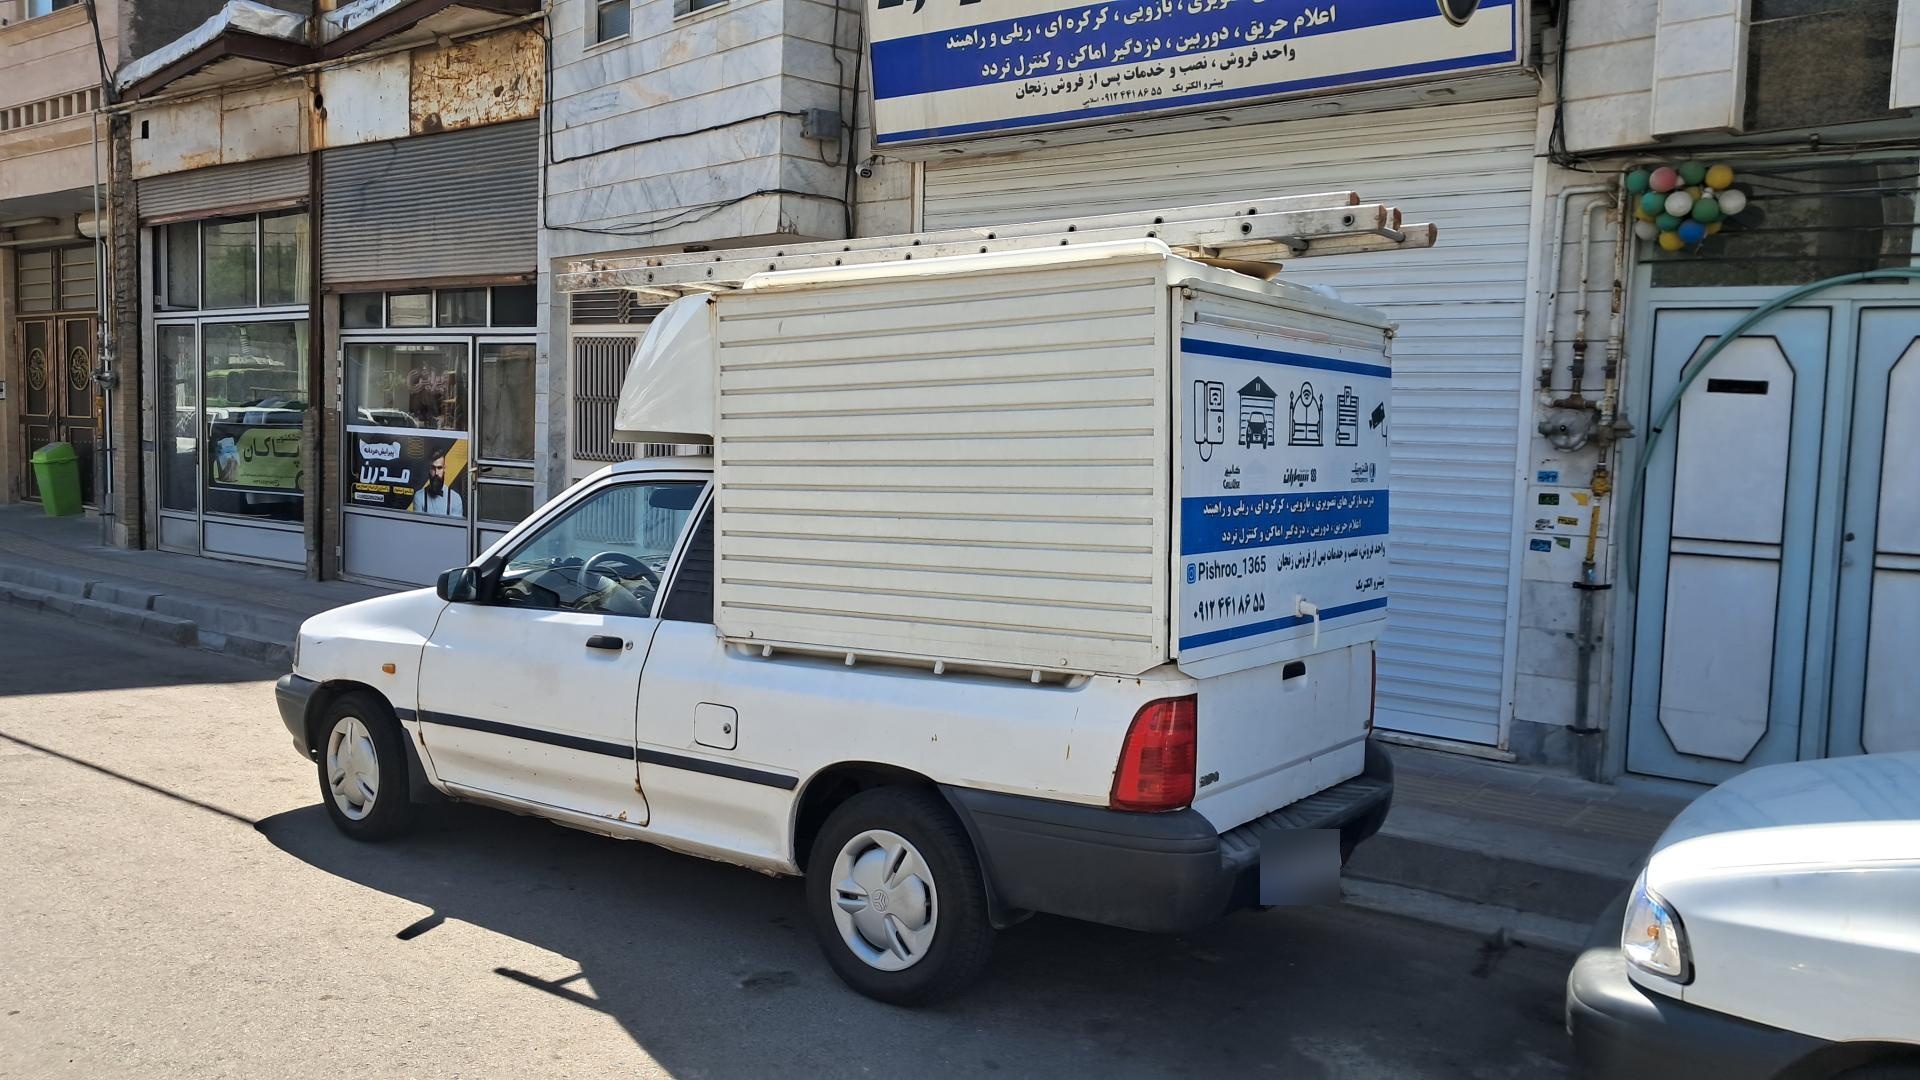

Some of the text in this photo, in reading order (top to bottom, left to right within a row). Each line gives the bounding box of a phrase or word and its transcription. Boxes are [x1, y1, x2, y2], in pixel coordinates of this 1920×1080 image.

[1067, 7, 1109, 33] کرکره
[1123, 0, 1173, 24] بازویی
[1293, 5, 1336, 34] اعلام
[1000, 22, 1032, 45] ریلی
[1044, 15, 1063, 37] ای
[1244, 17, 1288, 41] حریق
[946, 29, 986, 50] راهبند
[990, 32, 997, 46] و
[1175, 26, 1229, 51] دوربین
[1067, 42, 1106, 68] اماکن
[1110, 37, 1161, 62] دزدگیر
[1220, 47, 1258, 70] فروش
[1262, 43, 1296, 61] واحد
[981, 58, 1011, 79] تردد
[1014, 51, 1051, 76] کنترل
[1056, 56, 1063, 70] و
[1124, 61, 1165, 80] خدمات
[1169, 65, 1176, 78] و
[1179, 56, 1208, 75] نصب
[1051, 74, 1083, 95] فروش
[1087, 73, 1097, 90] از
[1101, 72, 1120, 87] پس
[1172, 80, 1201, 93] الکتریک
[1203, 79, 1224, 90] پیشرو
[1015, 82, 1048, 99] زنجان
[360, 461, 410, 484] مدرن
[1203, 501, 1226, 517] راهبند
[1232, 500, 1248, 516] ریلی
[1254, 499, 1264, 515] ای
[1265, 498, 1284, 514] کرکره
[1290, 497, 1310, 513] بازویی
[1315, 496, 1336, 511] تصویری
[1222, 529, 1238, 544] تردد
[1239, 527, 1258, 544] کنترل
[1265, 525, 1283, 541] اماکن
[1285, 524, 1305, 539] دزدگیر
[1310, 524, 1329, 536] دوربین
[1198, 555, 1266, 581] Pishroo_1365
[1277, 552, 1293, 571] زنجان
[1295, 549, 1311, 569] فروش
[1194, 592, 1265, 622] ۰۹۱۲ ۴۴۱ ۸۶ ۵۵
